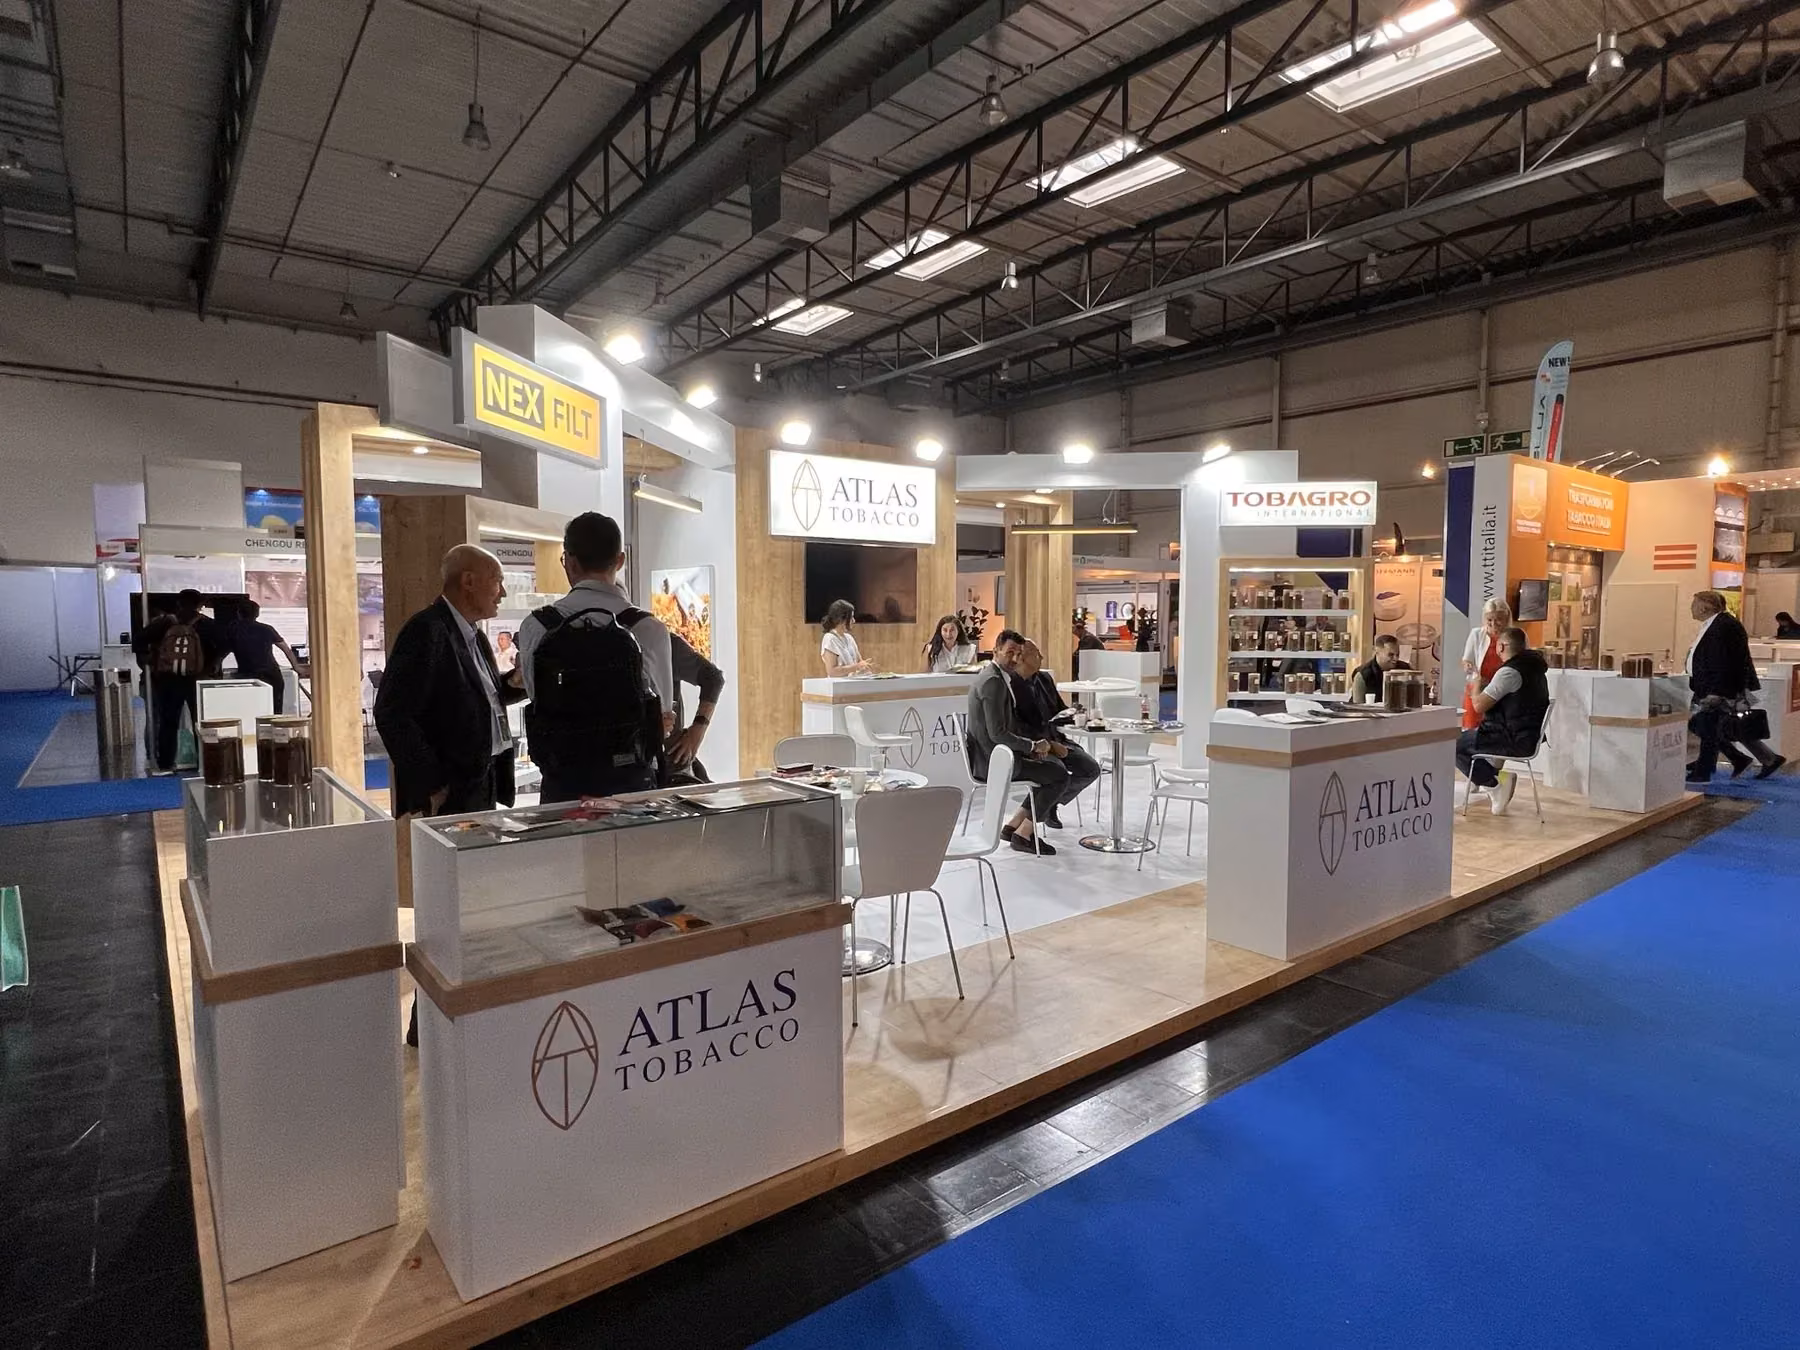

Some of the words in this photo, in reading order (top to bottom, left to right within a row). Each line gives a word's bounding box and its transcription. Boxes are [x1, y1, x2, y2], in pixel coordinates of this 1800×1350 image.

[1548, 356, 1571, 368] NEW!
[485, 366, 542, 424] NEX
[553, 397, 593, 441] FILT
[831, 476, 918, 508] ATLAS
[1226, 490, 1371, 507] TOBAGRO
[828, 506, 920, 528] TOBACCO
[1257, 508, 1371, 518] INTERNATIONAL
[931, 713, 968, 738] ATL
[929, 741, 961, 756] TOB
[1354, 772, 1433, 823] ATLAS
[1352, 812, 1433, 852] TOBACCO
[616, 968, 798, 1057] ATLAS
[614, 1017, 800, 1092] TOBACCO
